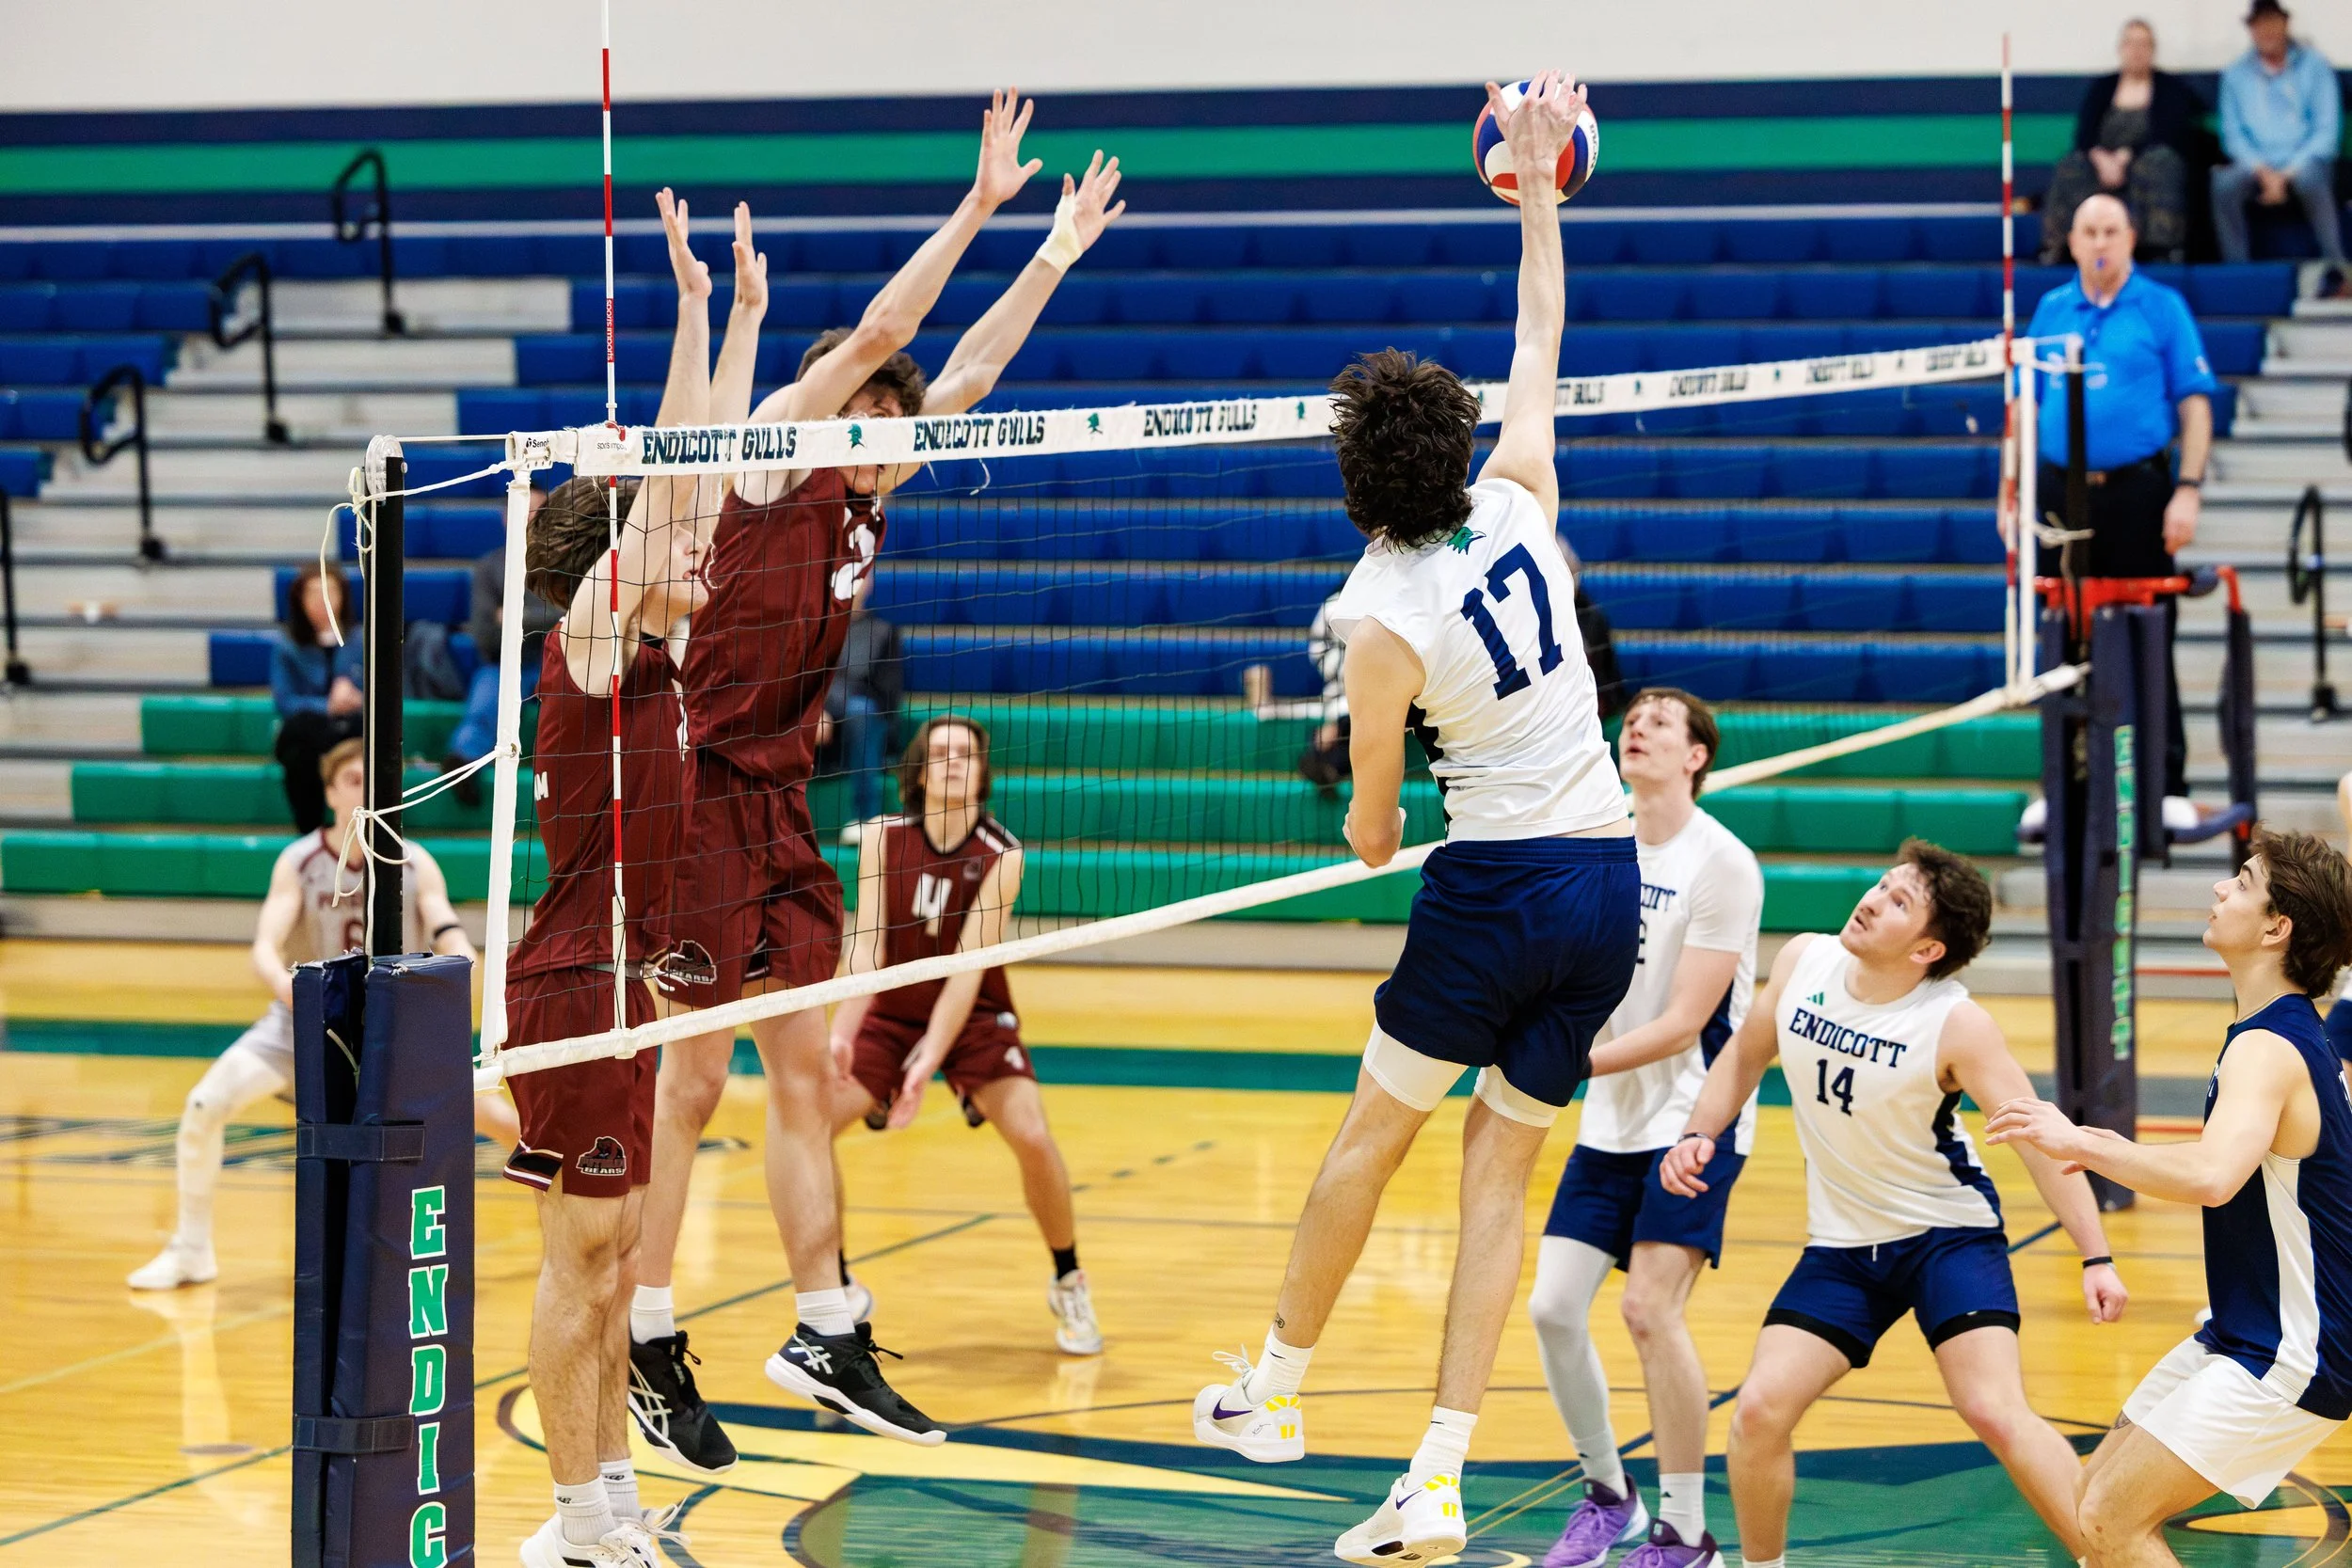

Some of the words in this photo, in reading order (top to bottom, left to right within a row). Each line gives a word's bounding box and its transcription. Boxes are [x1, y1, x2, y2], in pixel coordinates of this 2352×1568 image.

[642, 428, 737, 465] ENDICOTT
[741, 426, 798, 462] GULLS
[914, 419, 994, 452] ENDICOTT
[997, 415, 1045, 447] GULLS
[1460, 542, 1565, 702] 17
[911, 872, 954, 938] 4
[1788, 1007, 1907, 1069] ENDICOTT
[1817, 1058, 1855, 1117] 14
